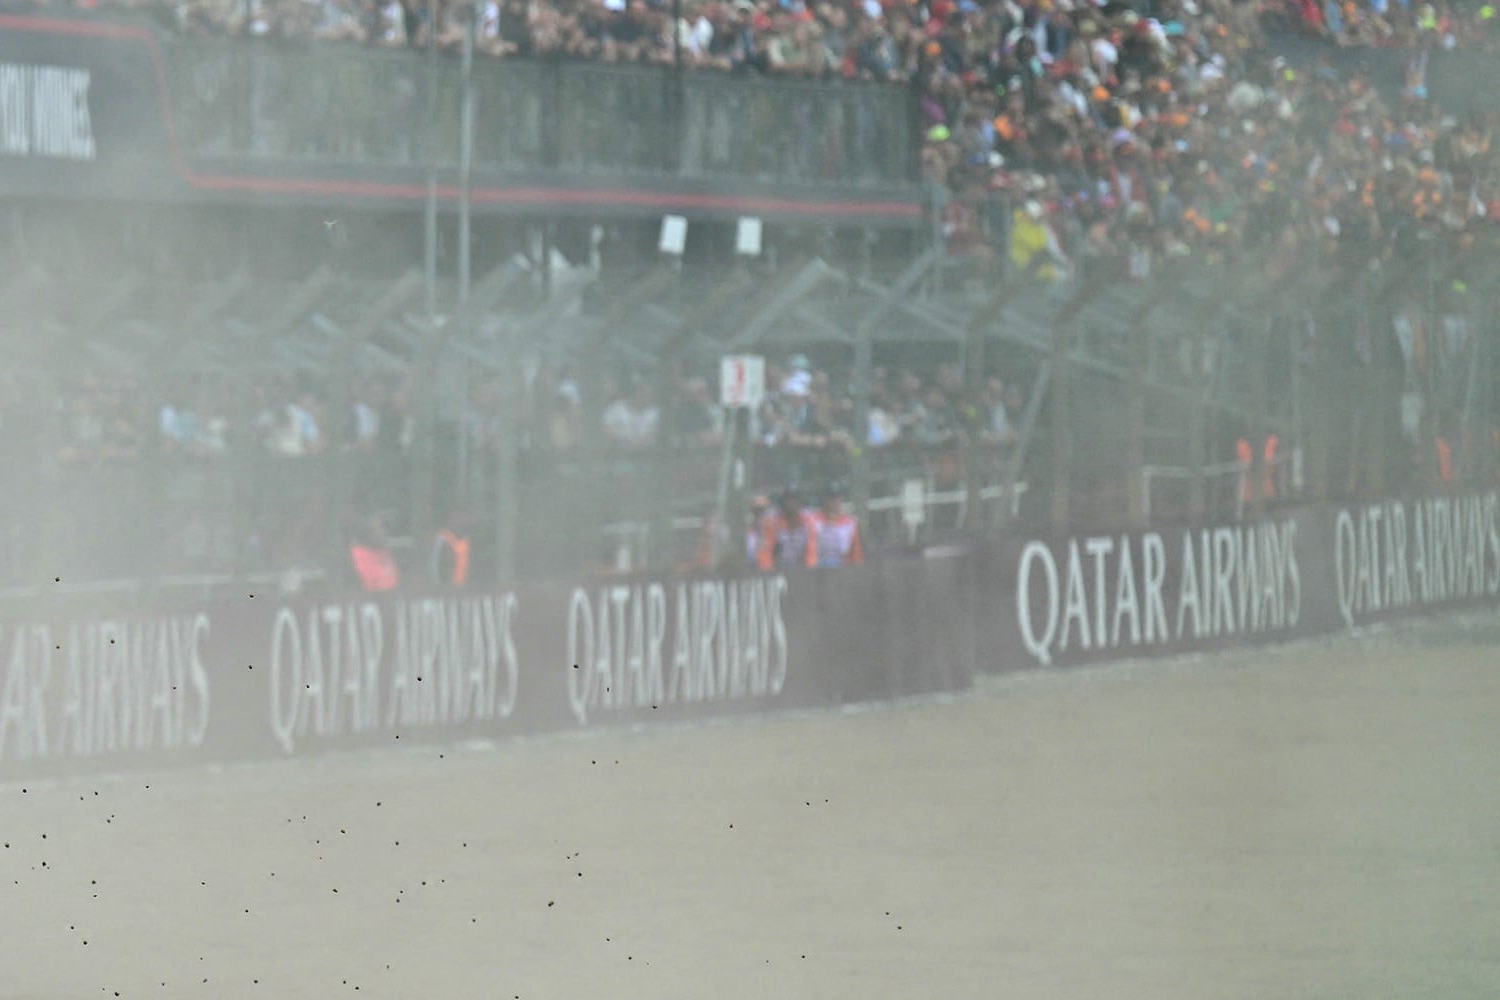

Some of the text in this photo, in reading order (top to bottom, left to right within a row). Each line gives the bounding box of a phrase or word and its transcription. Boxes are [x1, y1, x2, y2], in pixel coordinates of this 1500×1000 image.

[1016, 518, 1300, 666] QATAR AIRWAYS
[1335, 491, 1500, 630] QATAR AIRWAYS
[54, 612, 210, 756] AIRWAYS
[270, 591, 519, 753] QATAR AIRWAYS
[567, 574, 788, 726] QATAR AIRWAYS
